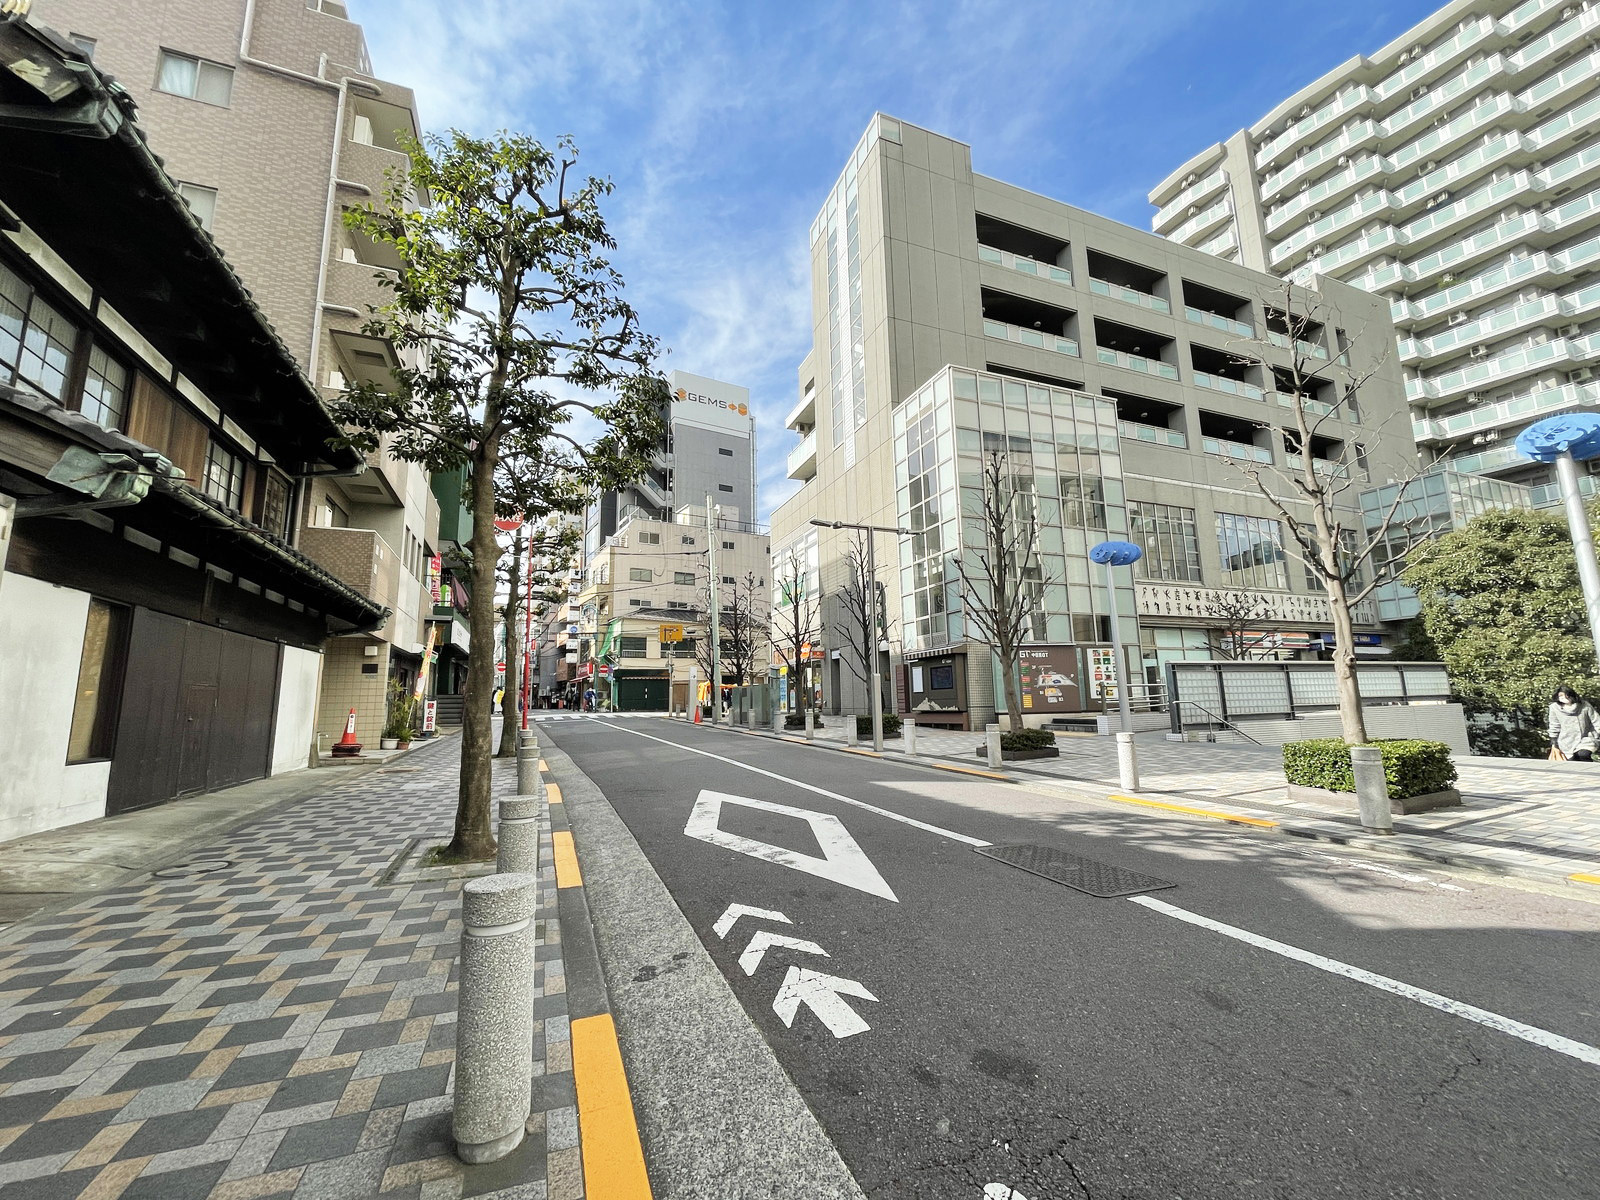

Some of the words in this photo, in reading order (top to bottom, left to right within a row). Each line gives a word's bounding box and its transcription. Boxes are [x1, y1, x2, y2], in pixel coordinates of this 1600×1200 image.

[688, 392, 728, 409] GEMS
[425, 702, 435, 730] 鍵と錠前
